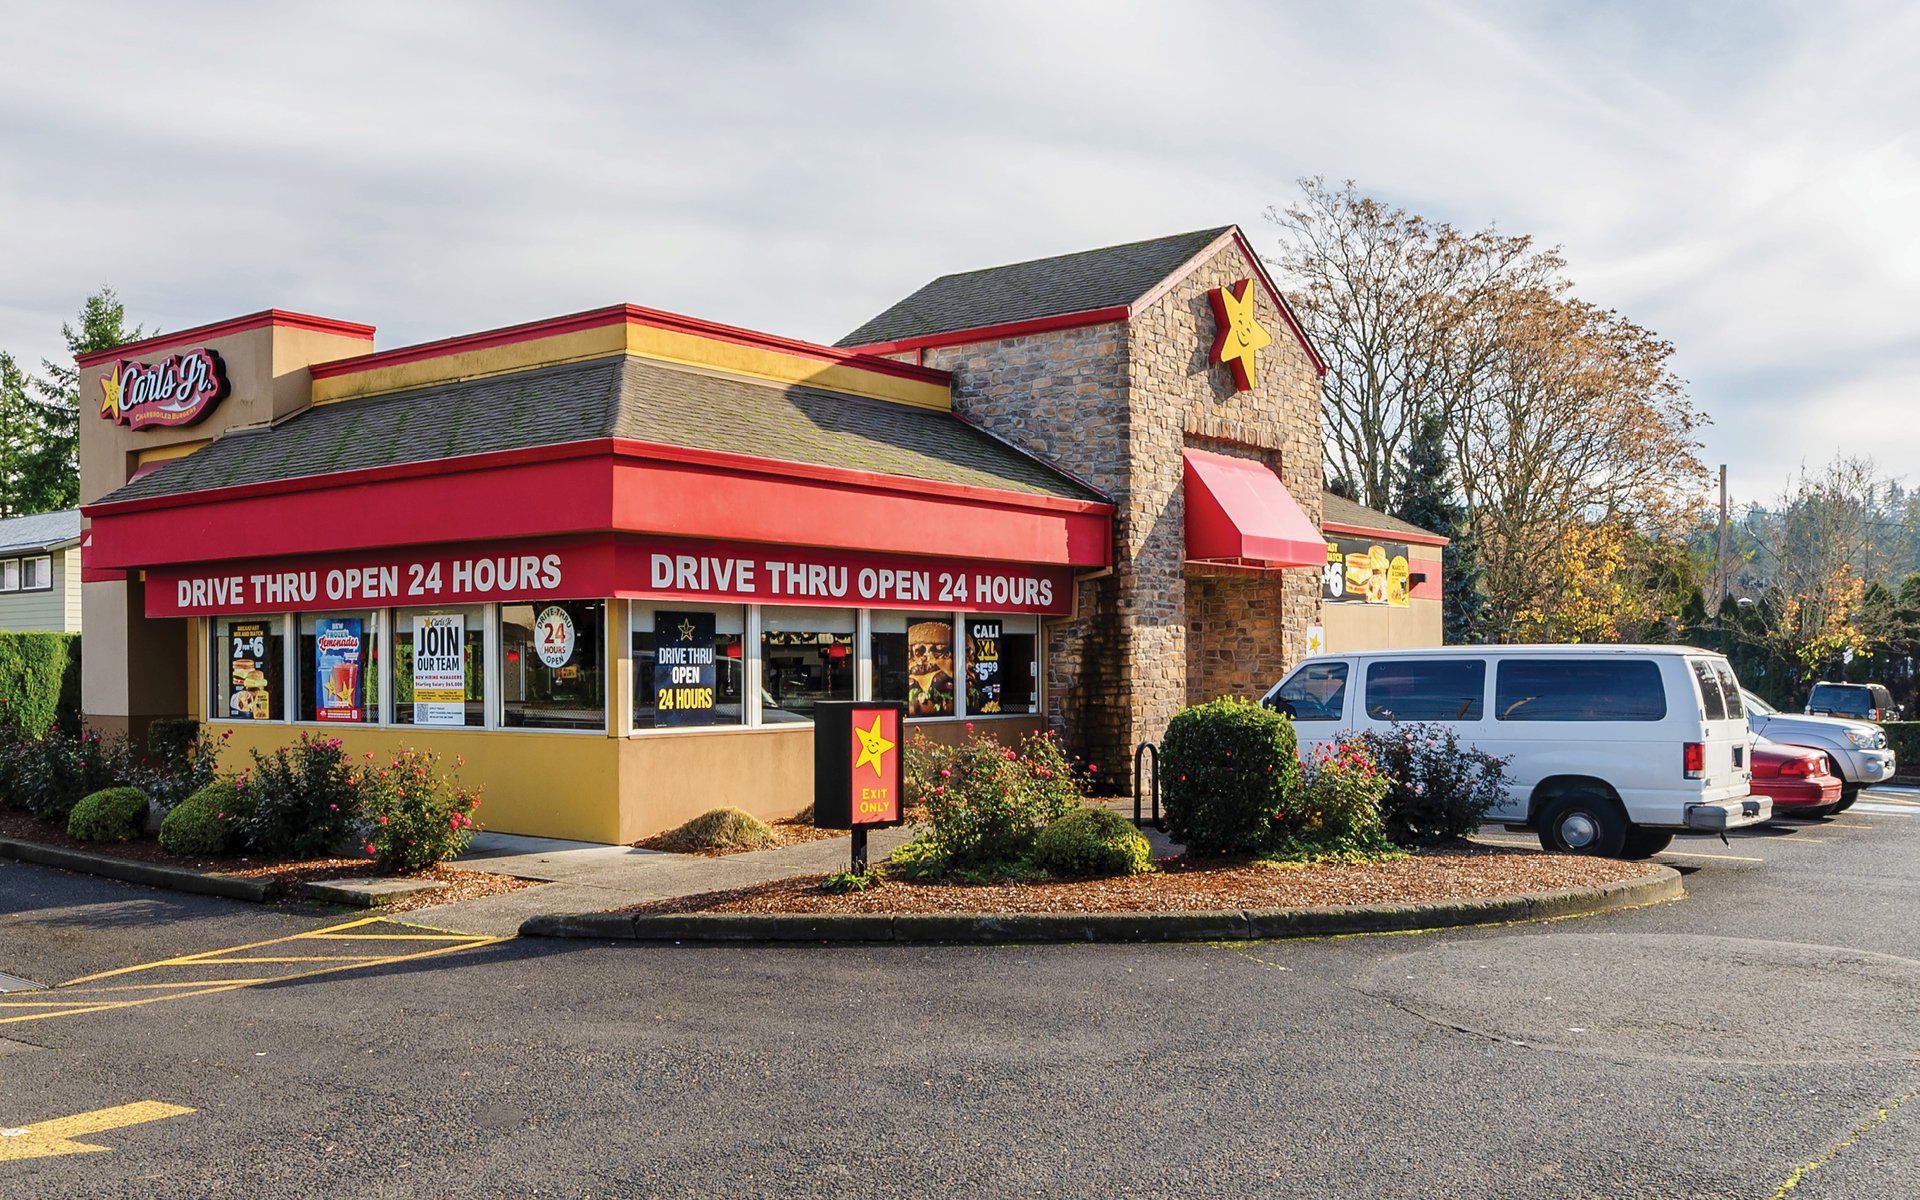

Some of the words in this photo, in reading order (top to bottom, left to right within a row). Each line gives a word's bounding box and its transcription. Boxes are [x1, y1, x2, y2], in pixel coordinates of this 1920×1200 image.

[118, 358, 176, 411] Carl's
[176, 354, 212, 400] Jr.
[177, 576, 244, 608] DRIVE
[250, 571, 317, 604] THRU
[326, 566, 398, 601] OPEN
[408, 562, 442, 596] 24
[452, 554, 562, 593] HOURS
[651, 553, 755, 592] DRIVE
[766, 561, 848, 597] THRU
[858, 567, 930, 601] OPEN
[938, 572, 968, 602] 24
[975, 575, 1053, 606] HOURS
[537, 607, 572, 630] DRIVE-THRU
[326, 629, 349, 638] FROZEN
[544, 623, 565, 644] 24
[973, 624, 999, 638] CALI
[233, 637, 243, 658] 2
[249, 636, 264, 657] $6
[318, 635, 358, 652] Lemonades
[418, 626, 459, 657] JOIN
[544, 646, 566, 654] HOURS
[977, 639, 999, 661] XL
[417, 657, 435, 671] OUR
[436, 657, 460, 671] TEAM
[546, 655, 564, 665] OPEN
[658, 647, 687, 665] DRIVE
[688, 647, 713, 665] THRU
[672, 666, 700, 684] OPEN
[658, 688, 674, 710] 24
[675, 687, 713, 710] HOURS
[862, 788, 888, 800] EXIT
[860, 801, 890, 814] ONLY
